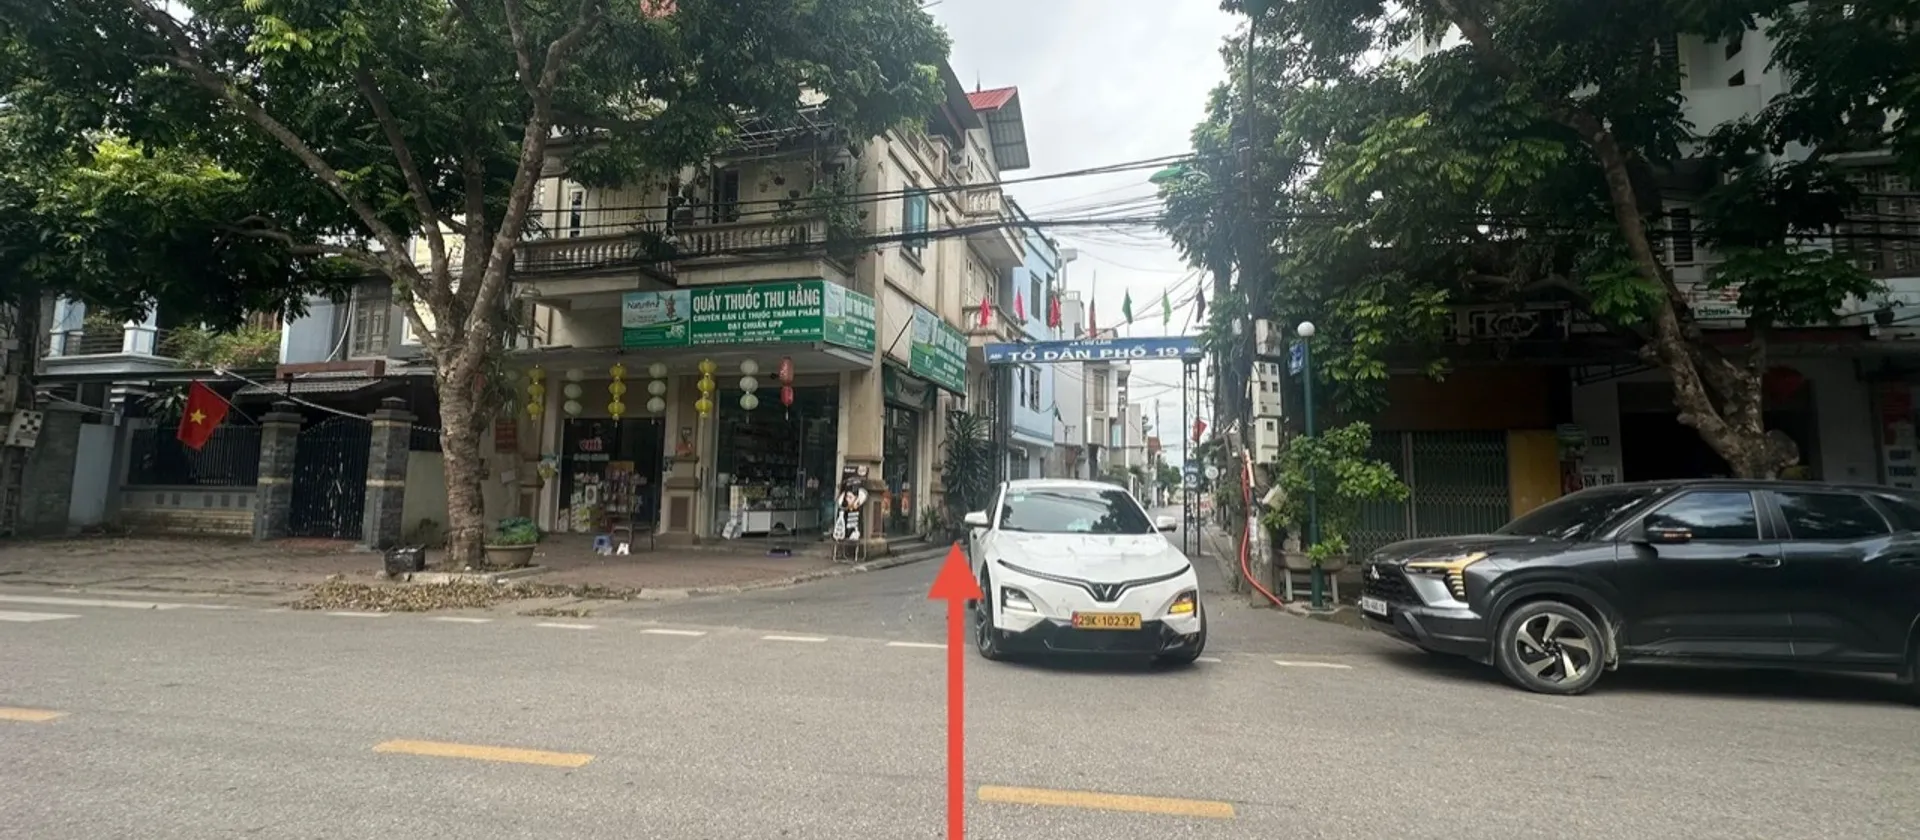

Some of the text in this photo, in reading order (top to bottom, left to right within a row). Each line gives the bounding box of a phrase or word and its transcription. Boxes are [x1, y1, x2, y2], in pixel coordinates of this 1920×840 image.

[724, 287, 761, 310] THUỐC
[764, 290, 785, 308] THU
[788, 283, 820, 306] HẰNG
[1008, 343, 1179, 361] TỔ DÂN PHỐ 19
